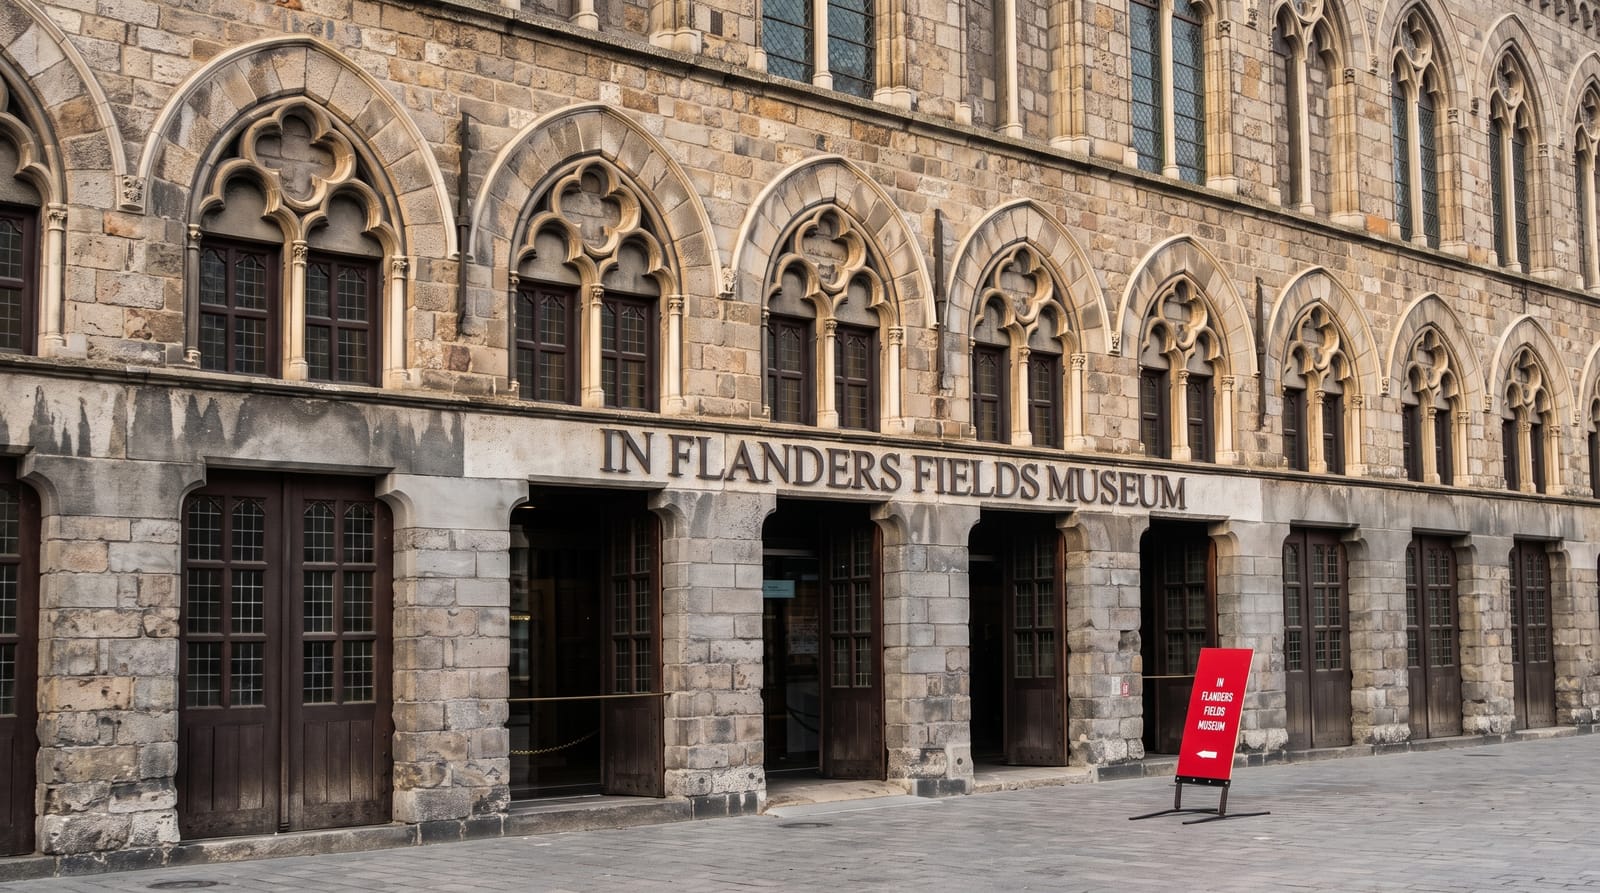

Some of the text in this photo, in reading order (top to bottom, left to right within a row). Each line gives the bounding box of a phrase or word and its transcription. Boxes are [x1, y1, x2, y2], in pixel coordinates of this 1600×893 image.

[600, 428, 1187, 510] IN FLANDERS FIELDS MUSEUM
[1216, 677, 1224, 687] IN
[1201, 691, 1233, 702] FLANDERS
[1203, 705, 1225, 716] FIELDS
[1197, 720, 1225, 731] MUSEUM
